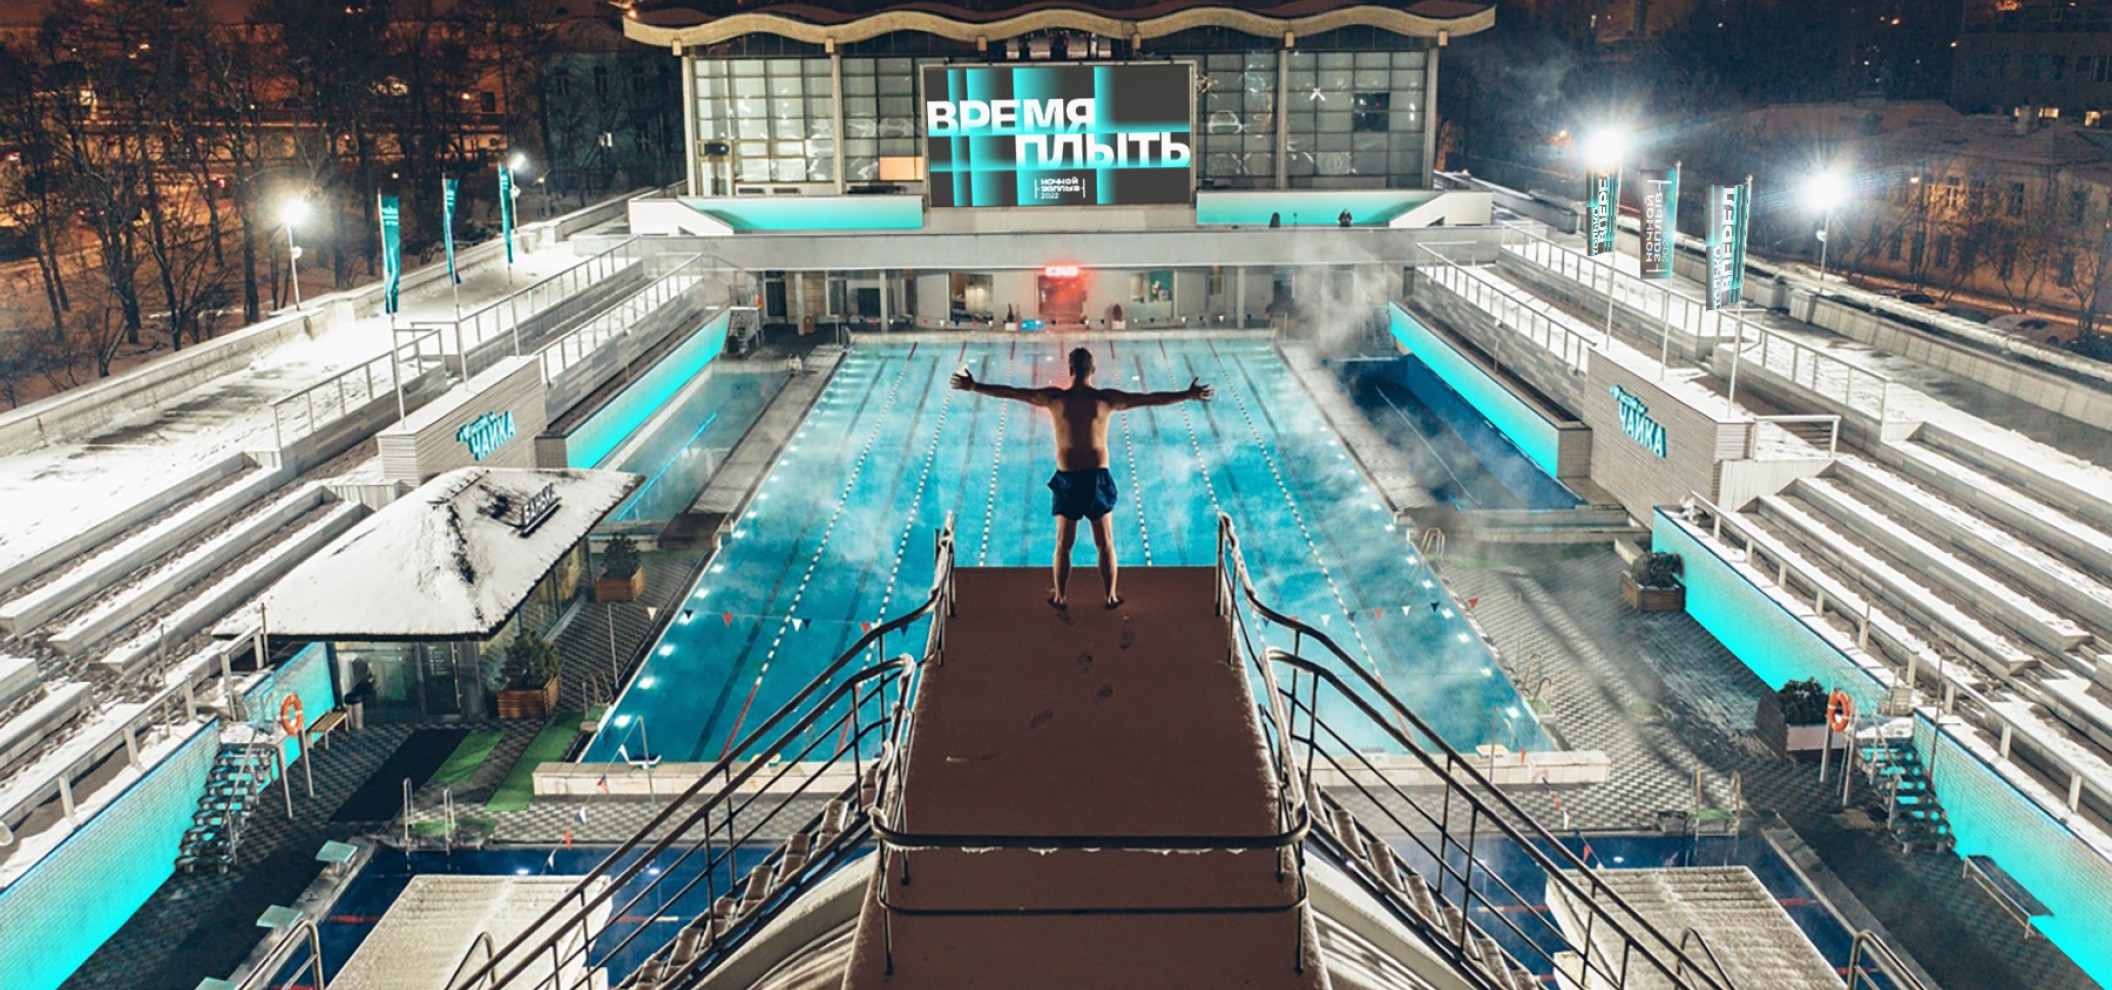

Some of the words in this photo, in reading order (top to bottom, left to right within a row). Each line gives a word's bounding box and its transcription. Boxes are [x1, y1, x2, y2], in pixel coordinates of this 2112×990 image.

[927, 98, 1096, 135] ВРЕМЯ
[1015, 131, 1191, 168] ПЛЫТЬ
[1721, 187, 1735, 292] ВПЕРЕД
[470, 411, 516, 461] ЧАЙКА
[1618, 402, 1665, 458] ЧАЙКА
